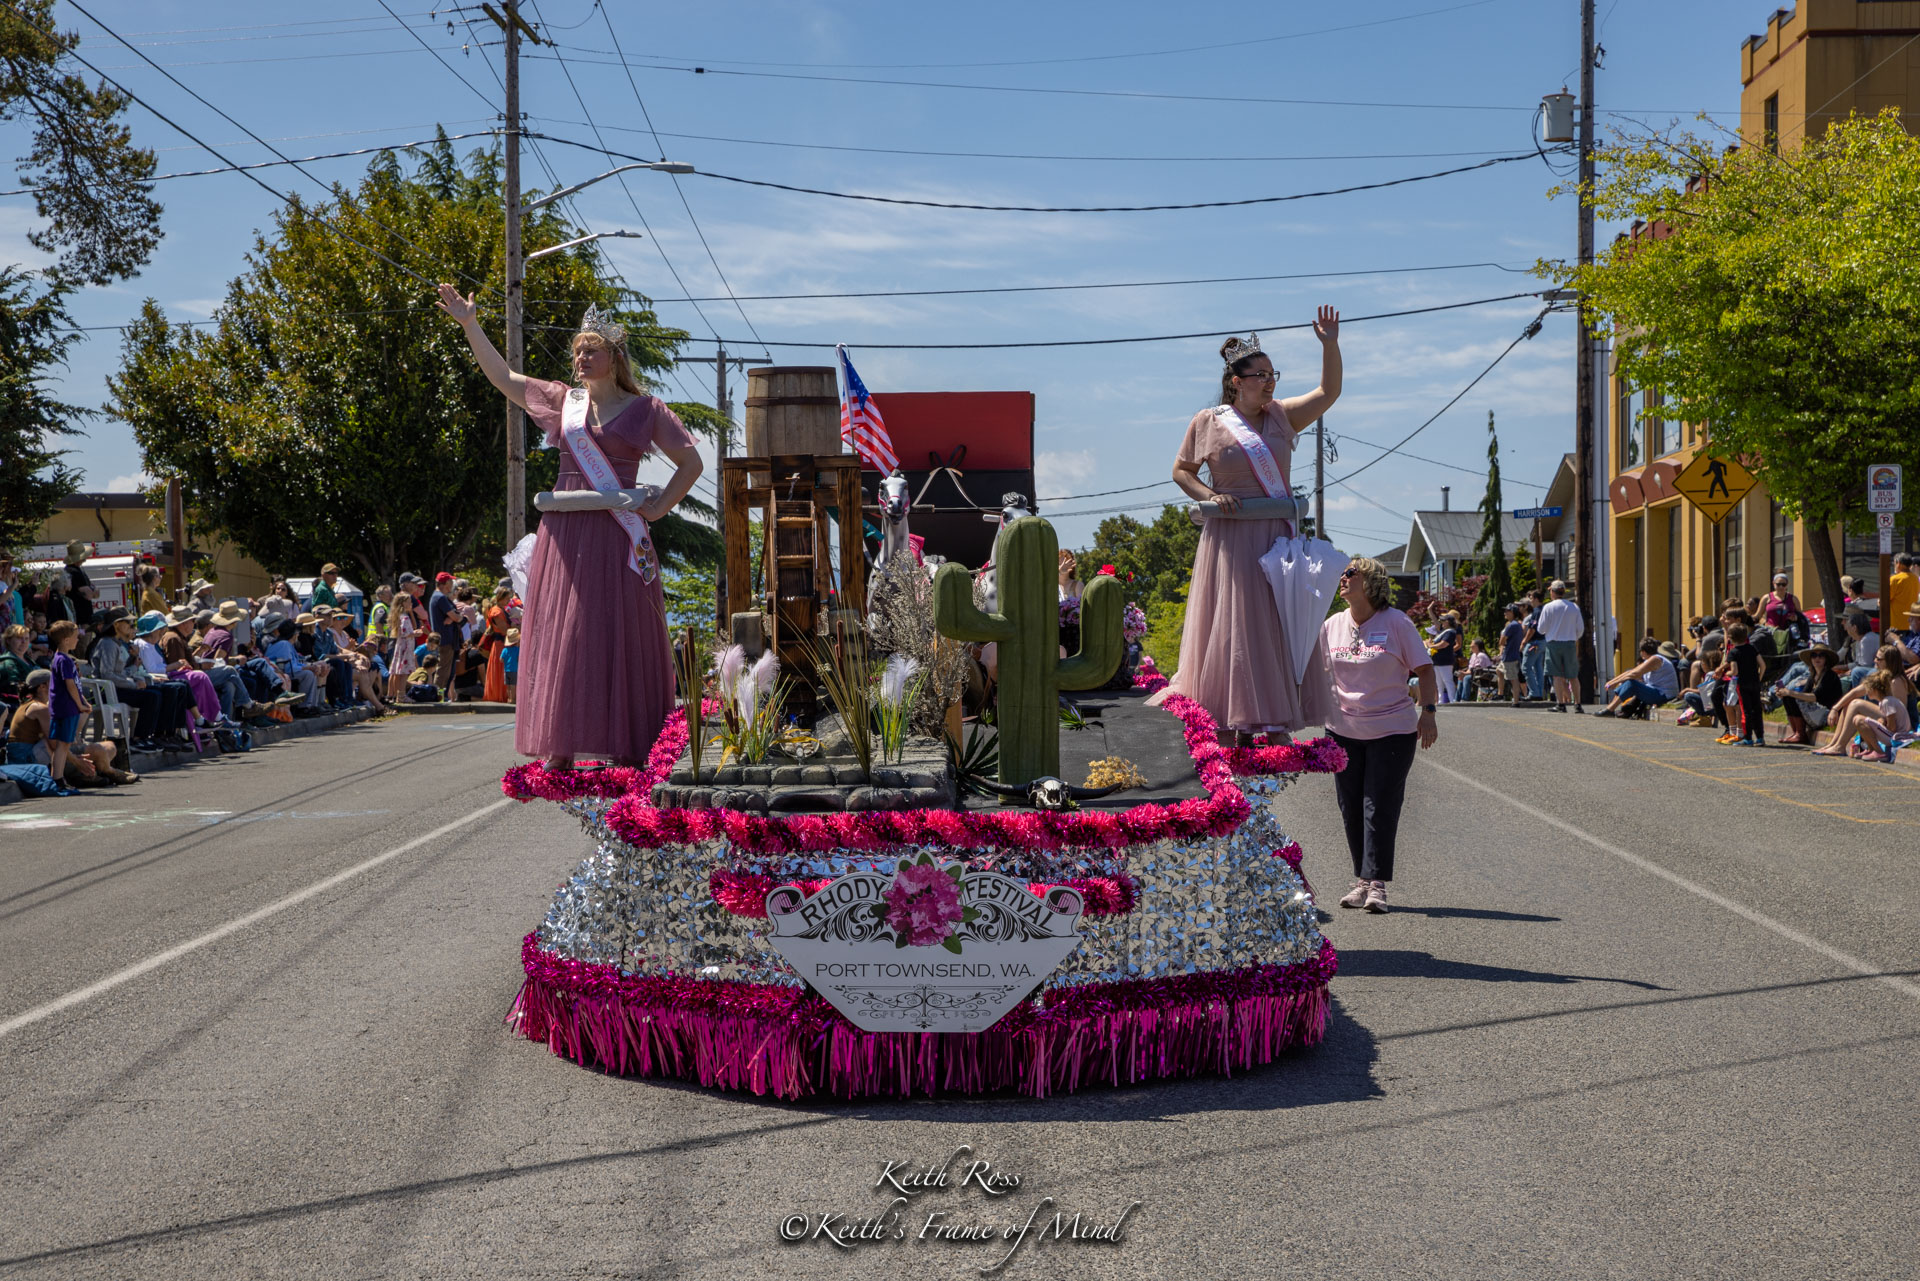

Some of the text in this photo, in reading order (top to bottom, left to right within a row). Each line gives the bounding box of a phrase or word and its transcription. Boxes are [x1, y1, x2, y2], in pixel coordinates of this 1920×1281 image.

[577, 438, 604, 479] Queen
[1251, 443, 1275, 485] Princess
[1517, 509, 1550, 517] HARRISON
[800, 877, 1055, 932] RHODY FESTIVAL
[815, 963, 1037, 980] PORT TOWNSEND, WA.
